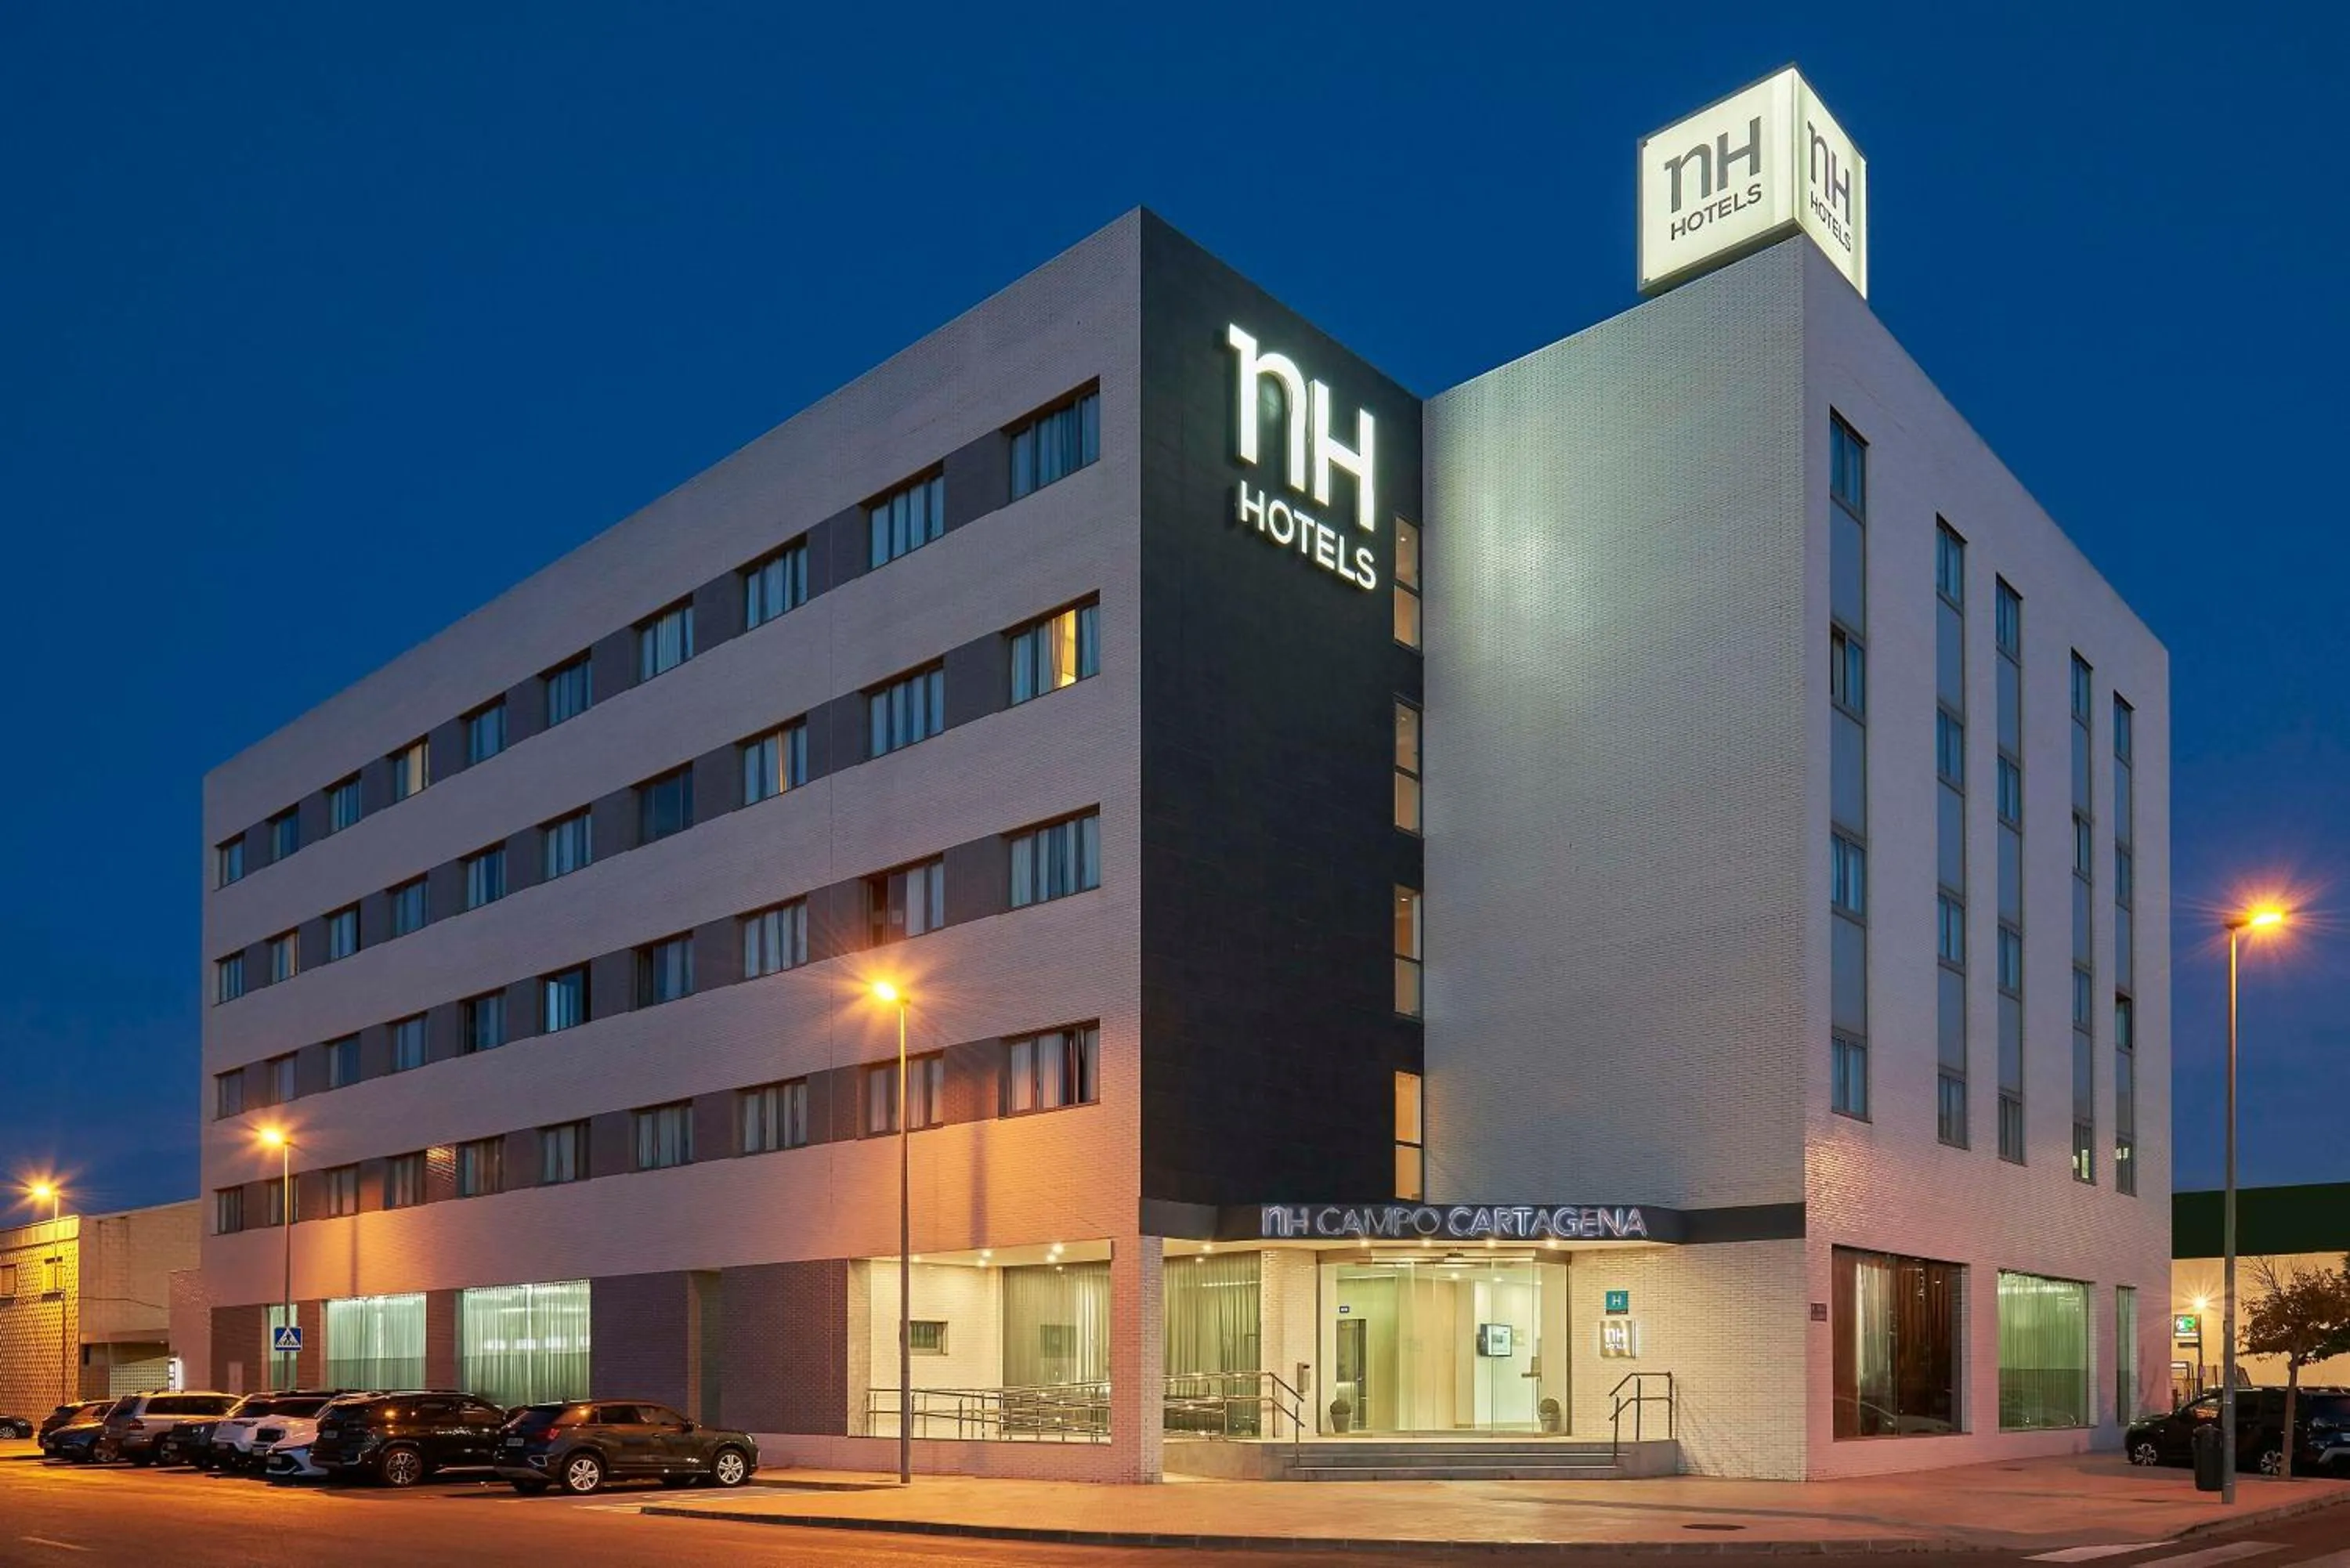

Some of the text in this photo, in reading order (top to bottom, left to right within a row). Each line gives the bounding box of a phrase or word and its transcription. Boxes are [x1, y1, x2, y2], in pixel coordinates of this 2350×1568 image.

[1670, 183, 1762, 241] HOTELS
[1810, 191, 1852, 253] HOTELS
[1240, 479, 1377, 591] HOTELS
[1317, 1207, 1441, 1237] CAMPO
[1448, 1206, 1648, 1237] CARTAGENA
[1612, 1295, 1622, 1306] H
